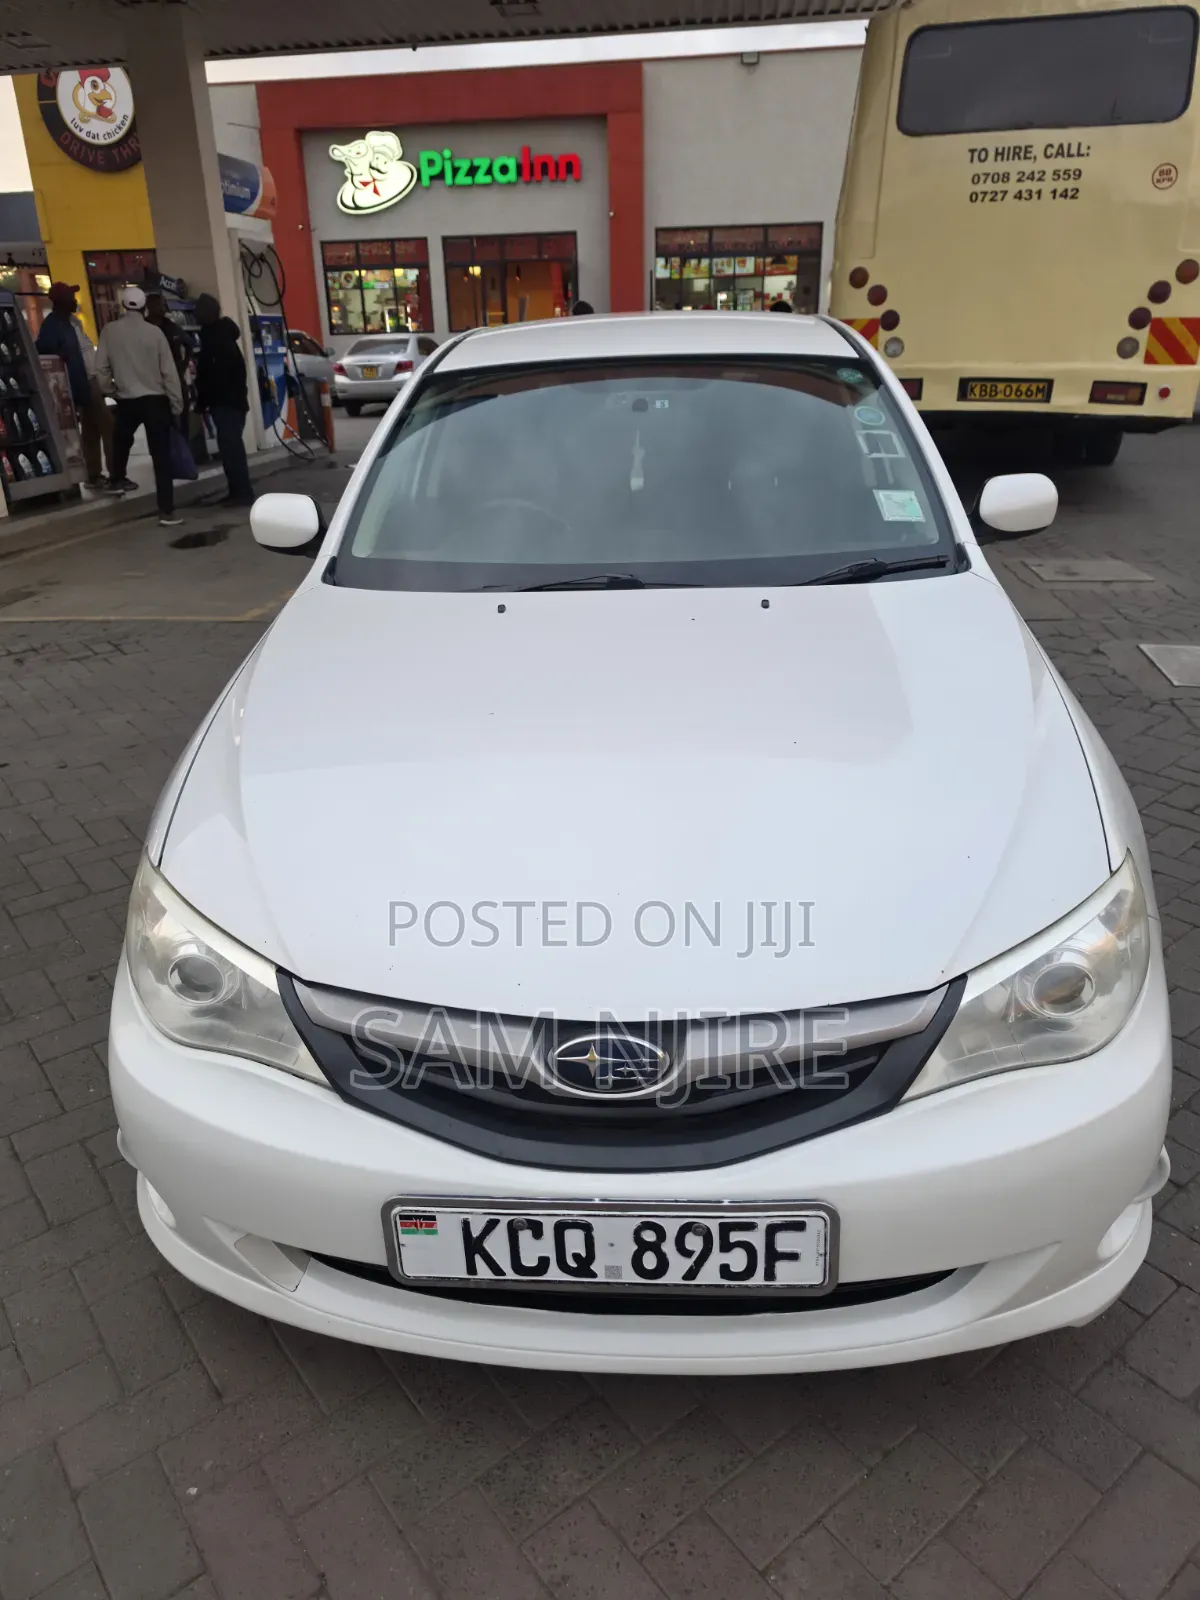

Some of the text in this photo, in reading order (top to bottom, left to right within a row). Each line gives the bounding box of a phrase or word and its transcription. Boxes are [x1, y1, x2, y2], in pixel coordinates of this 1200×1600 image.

[70, 114, 129, 141] luv dat chicken
[60, 131, 105, 165] DRIVE
[968, 142, 1091, 164] TO HIRE, CALL:
[971, 168, 1083, 185] 0708 242 559
[969, 187, 1080, 204] 0727 431 142
[461, 1217, 598, 1279] KCQ
[631, 1219, 807, 1282] 895F
